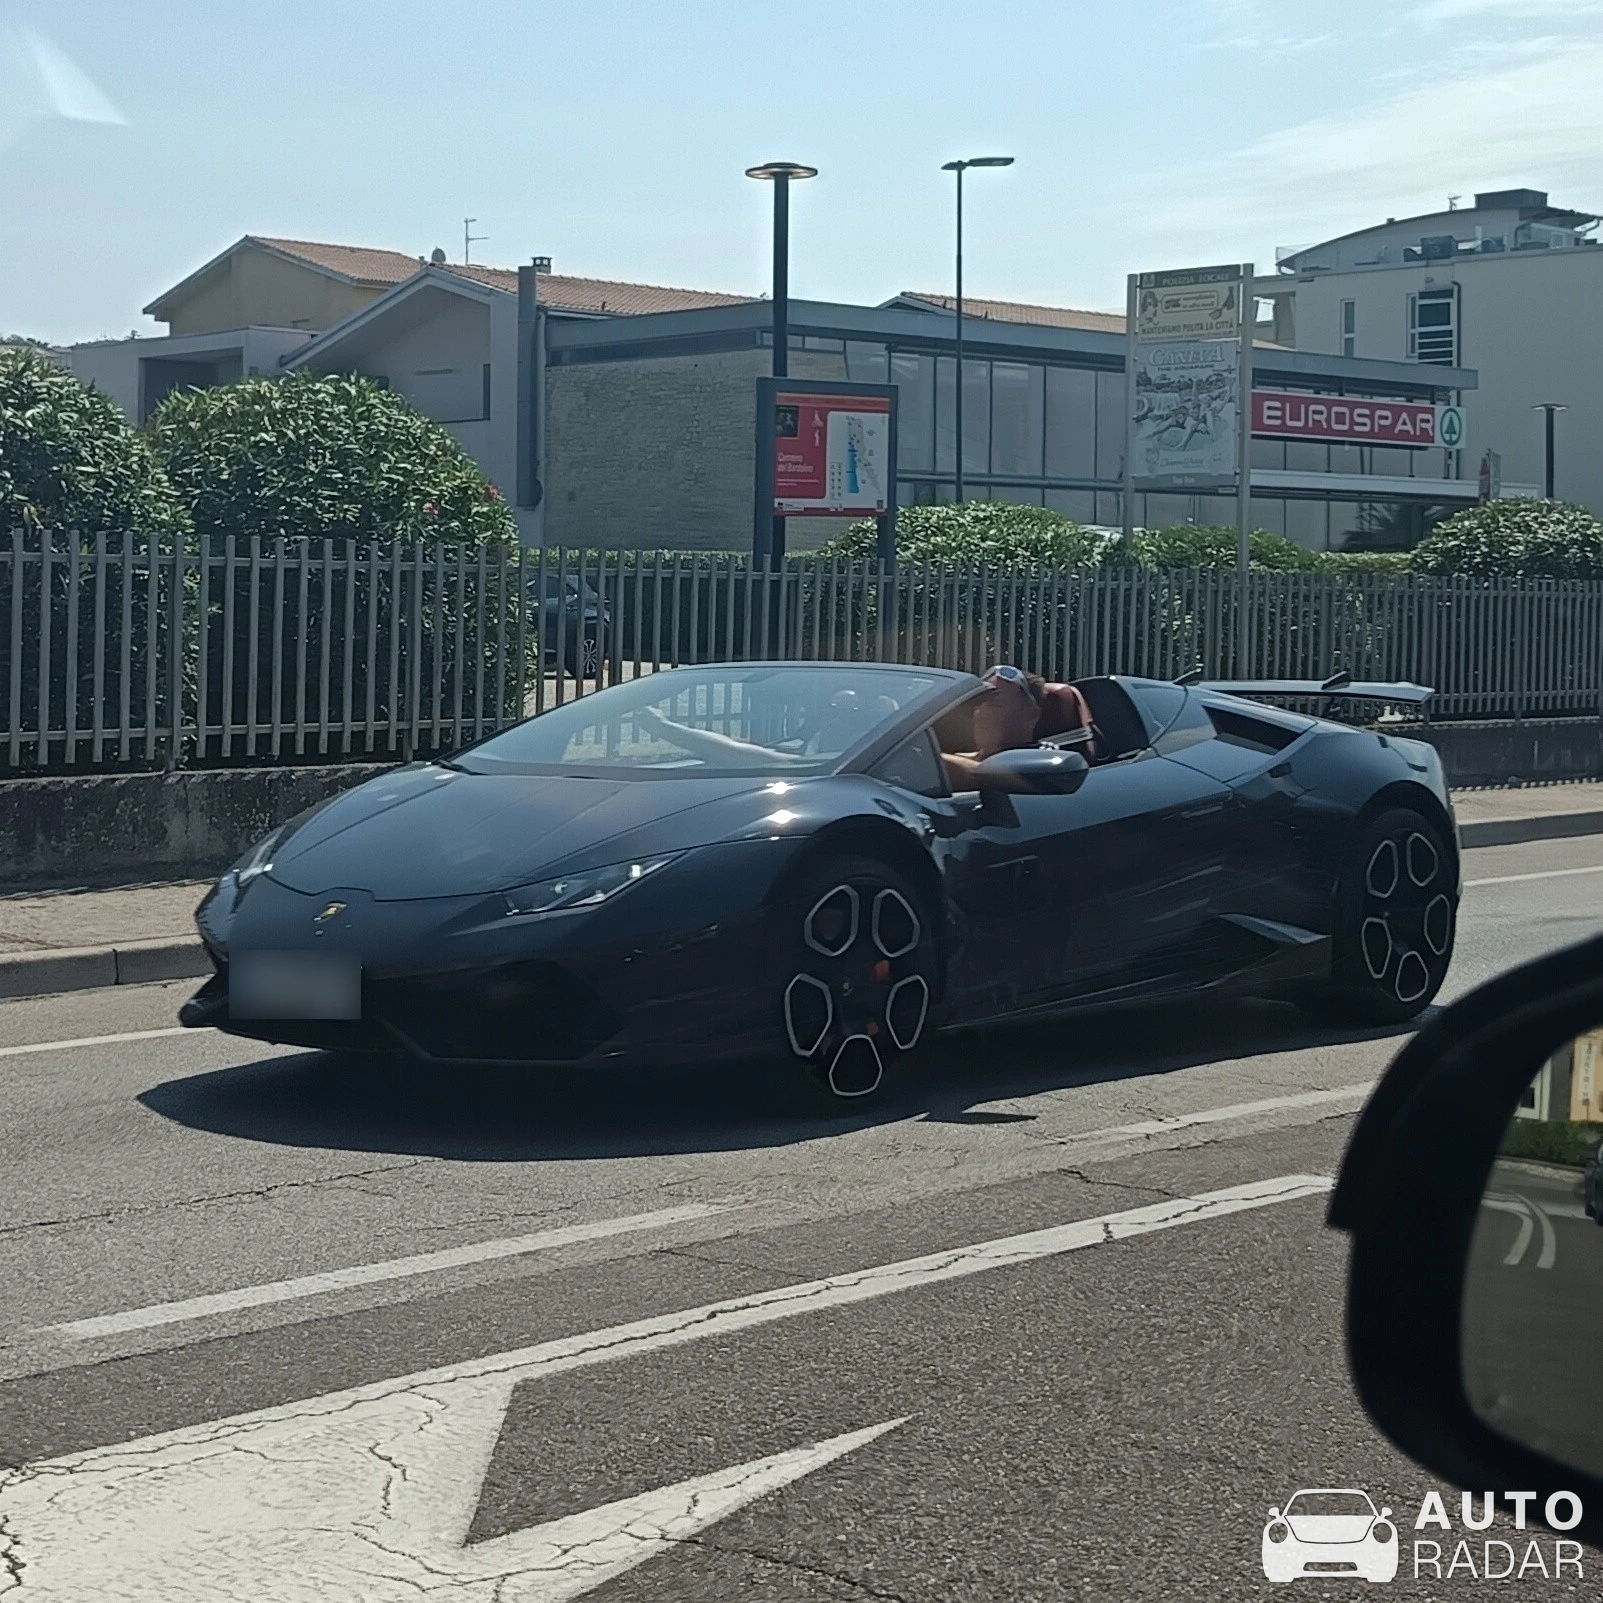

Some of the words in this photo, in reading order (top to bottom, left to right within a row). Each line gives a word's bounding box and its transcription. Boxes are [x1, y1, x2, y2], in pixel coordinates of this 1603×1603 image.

[1162, 276, 1195, 285] POLIZIA
[1198, 273, 1229, 283] LOCALE
[1141, 325, 1182, 335] MANTENIAMO
[1182, 323, 1204, 332] PULITA
[1205, 322, 1213, 331] LA
[1262, 400, 1433, 436] EUROSPAR
